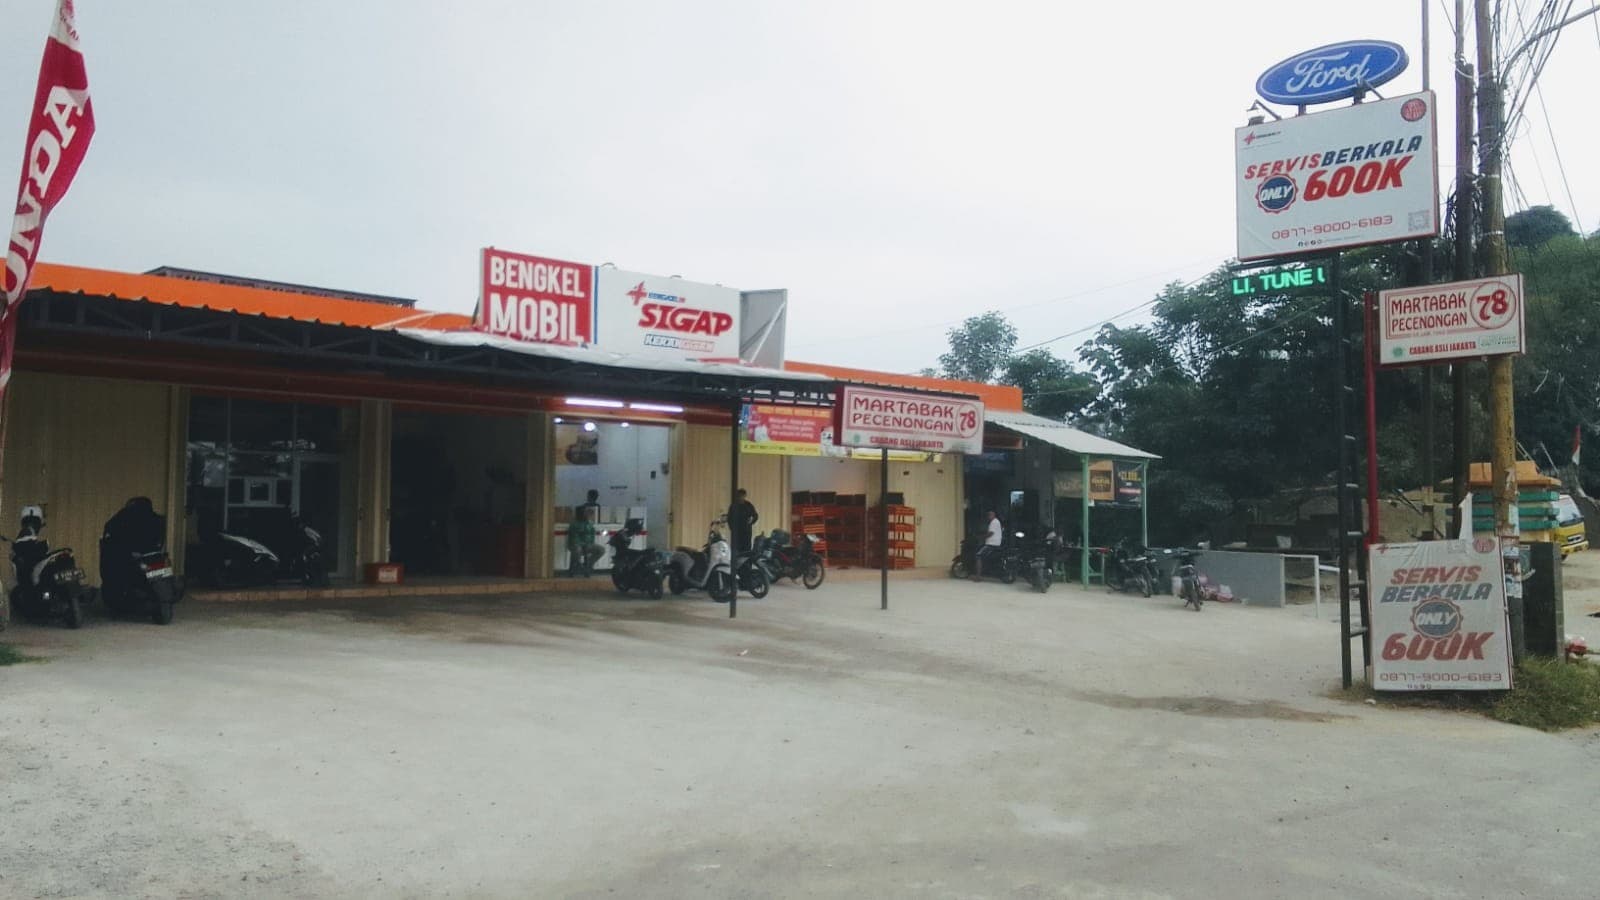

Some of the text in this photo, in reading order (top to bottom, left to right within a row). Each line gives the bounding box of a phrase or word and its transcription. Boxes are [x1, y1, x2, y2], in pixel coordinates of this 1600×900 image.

[1286, 51, 1371, 93] Ford
[1303, 154, 1414, 202] 600K
[1259, 184, 1293, 202] ONLY
[1271, 215, 1393, 240] 0877-9000-6183
[490, 255, 585, 298] BENGKEL
[1259, 268, 1313, 291] TUNE
[1391, 292, 1467, 315] MARTABAK
[1477, 289, 1508, 320] 78
[490, 292, 585, 343] MOBIL
[638, 302, 733, 337] SIGAP
[1391, 312, 1467, 332] PECENONGAN
[854, 397, 954, 419] MARTABAK
[853, 412, 953, 431] PECENONGAN
[959, 410, 976, 431] 78
[1390, 565, 1482, 585] SERVIS
[1380, 582, 1493, 603] BERKALA
[1416, 611, 1457, 626] ONLY
